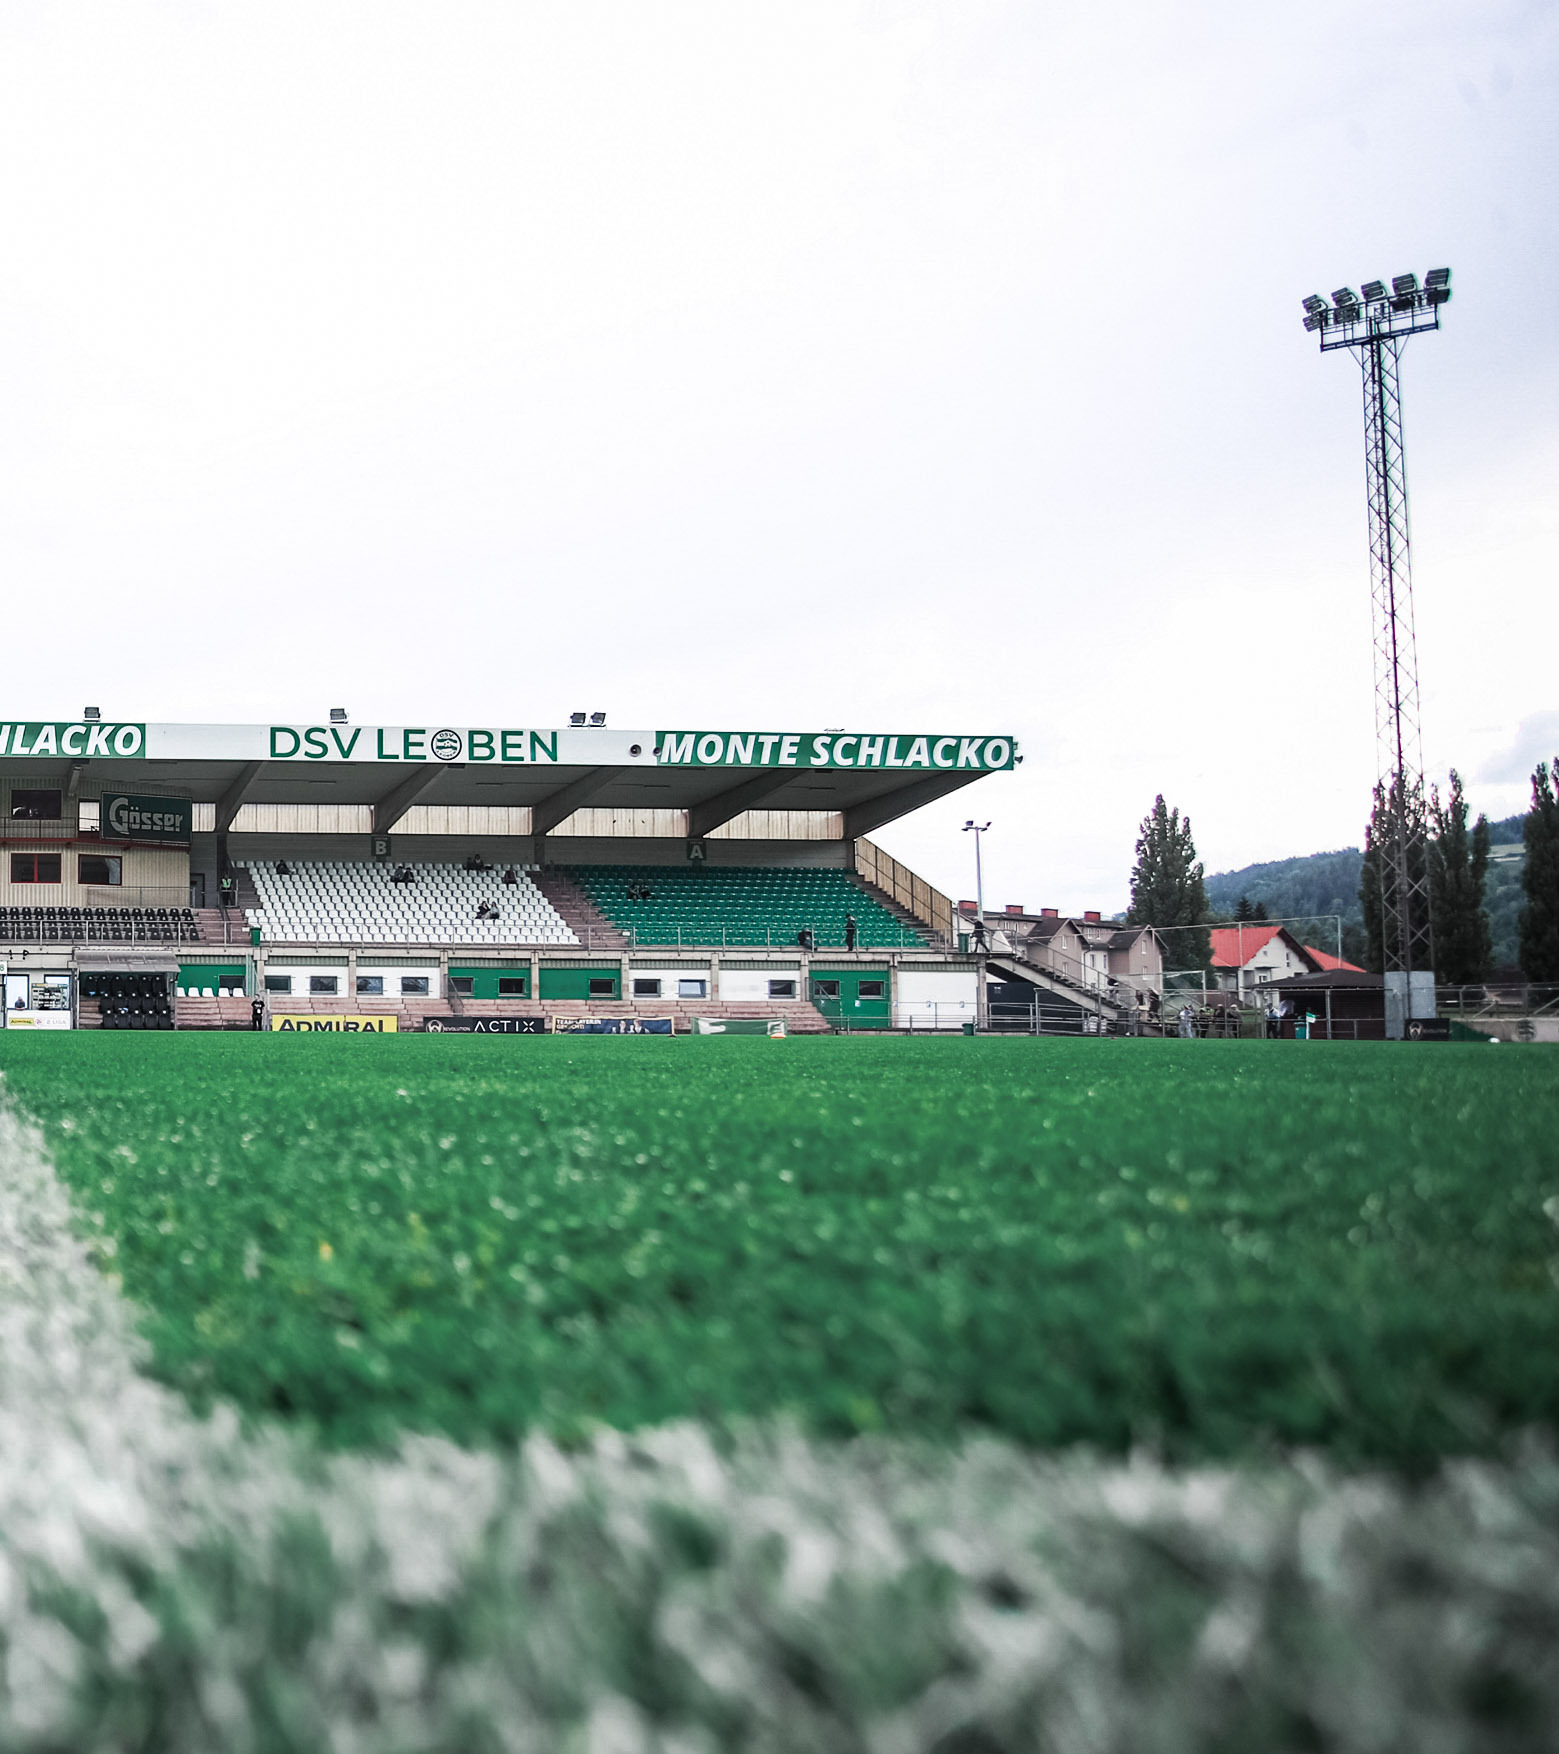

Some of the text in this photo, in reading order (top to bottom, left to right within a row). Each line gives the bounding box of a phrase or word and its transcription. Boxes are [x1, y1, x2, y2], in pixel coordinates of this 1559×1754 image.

[269, 727, 361, 759] DSV
[659, 733, 1011, 768] MONTE SCHLACKO
[109, 797, 183, 835] Gösser
[375, 840, 387, 855] B
[690, 844, 704, 859] A
[474, 1020, 535, 1032] ACTIX
